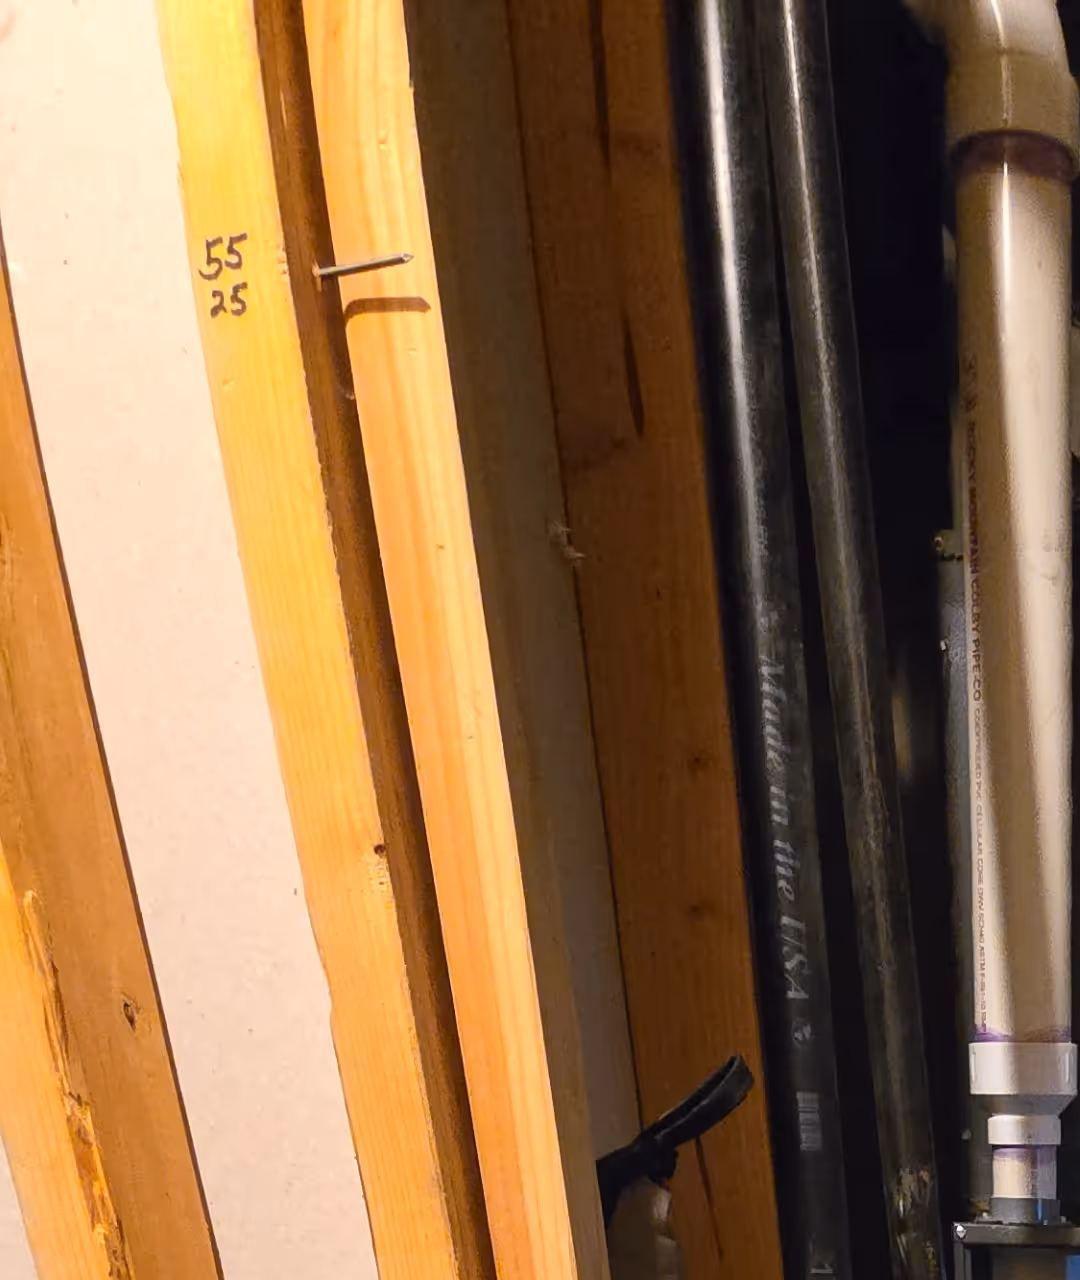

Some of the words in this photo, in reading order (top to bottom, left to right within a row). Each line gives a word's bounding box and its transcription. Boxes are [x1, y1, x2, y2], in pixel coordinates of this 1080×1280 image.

[198, 232, 247, 281] 55
[210, 281, 248, 318] 25
[970, 578, 981, 634] COLBY
[972, 638, 982, 701] PIPE-CO
[759, 656, 791, 769] Made
[769, 785, 789, 826] in
[773, 839, 799, 901] the
[780, 914, 812, 999] USA
